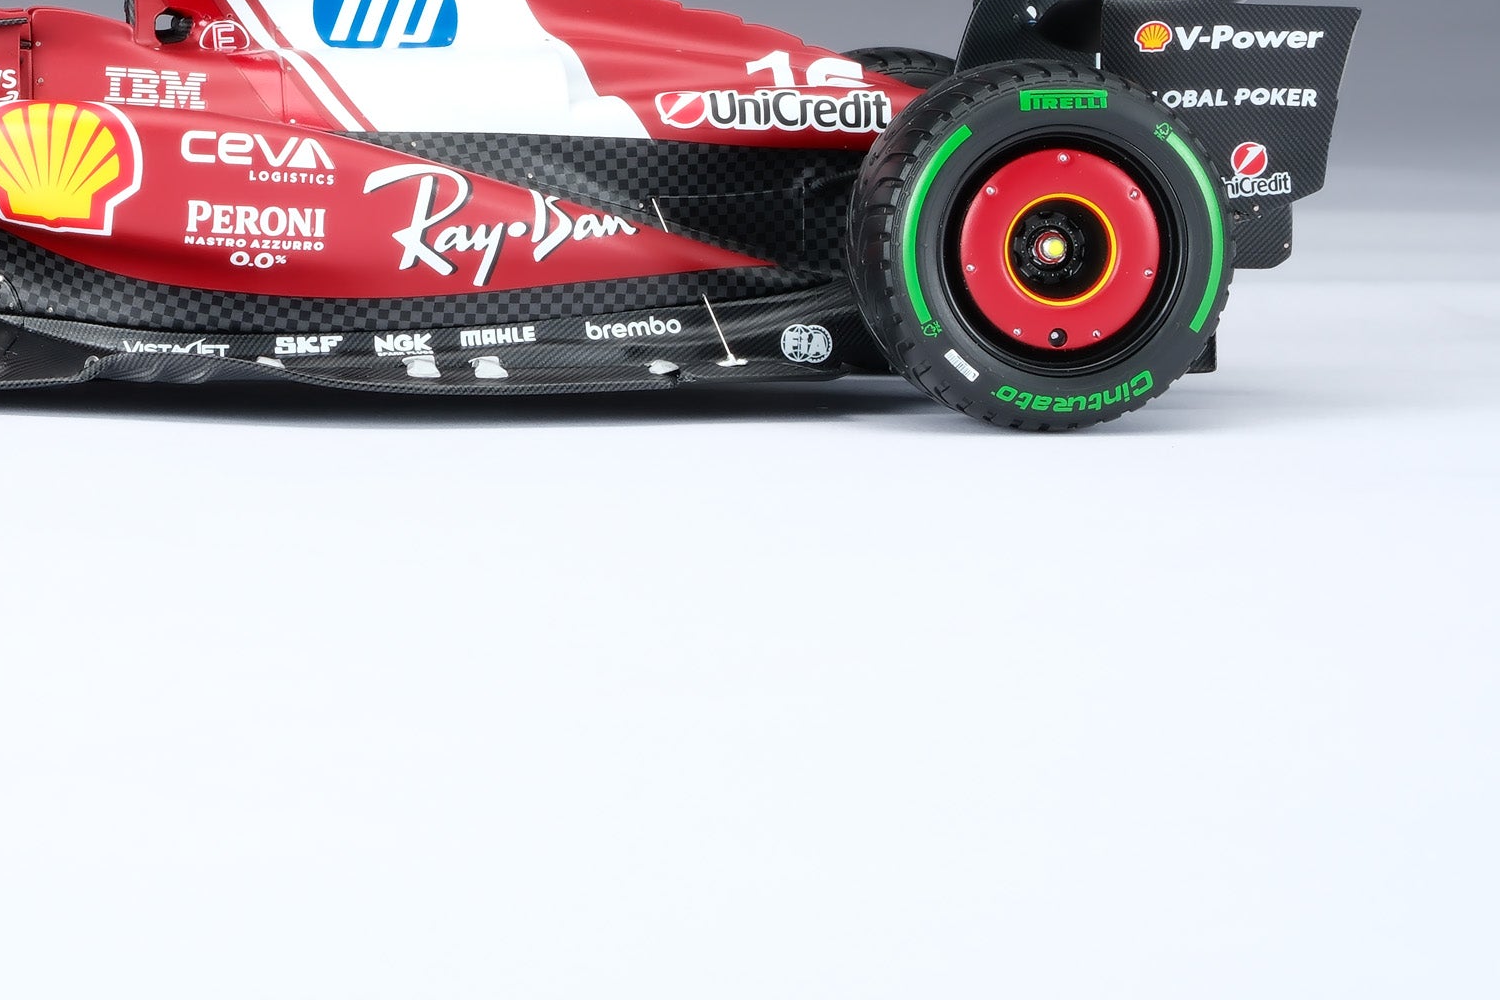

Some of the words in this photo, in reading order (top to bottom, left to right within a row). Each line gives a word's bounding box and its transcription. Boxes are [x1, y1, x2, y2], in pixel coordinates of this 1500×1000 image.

[1175, 25, 1324, 51] V-Power
[104, 66, 207, 110] IBM
[1152, 88, 1228, 109] OBAL
[1234, 88, 1318, 107] POKER
[709, 91, 887, 129] UniCredit
[1020, 89, 1108, 111] PIRELLI
[249, 170, 335, 186] LOGISTICS
[1227, 174, 1290, 195] niCredit
[186, 199, 326, 238] PERONI
[184, 235, 247, 248] NASTRO
[250, 239, 324, 251] AZZURRO
[229, 251, 287, 269] 0.0%
[460, 326, 537, 347] MAHLE
[585, 316, 682, 341] brembo
[274, 336, 343, 355] SKF
[374, 332, 433, 352] NGK
